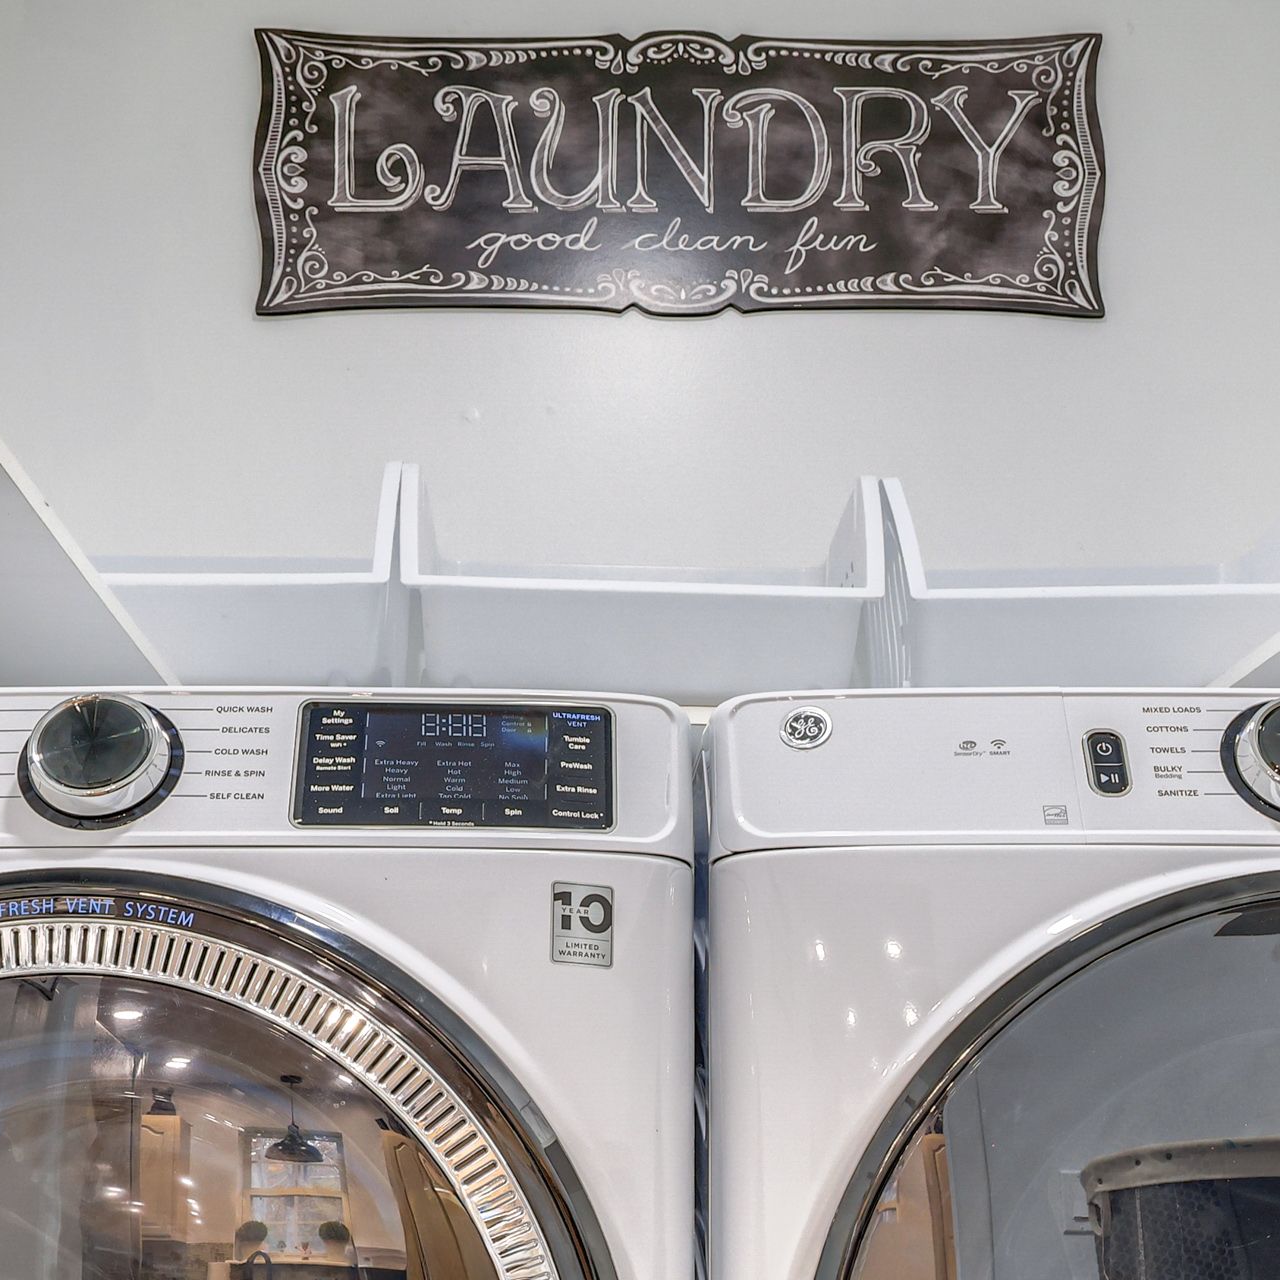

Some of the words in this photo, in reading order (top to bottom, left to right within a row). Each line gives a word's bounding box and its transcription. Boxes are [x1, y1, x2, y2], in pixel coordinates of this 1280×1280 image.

[328, 84, 1043, 214] LAUNDRY
[465, 217, 602, 269] good
[622, 217, 768, 252] clean
[785, 217, 878, 274] fun
[216, 706, 245, 714] QUICK
[552, 712, 601, 721] ULTRAFRESH
[322, 717, 353, 725] Settings
[1146, 725, 1189, 733] COTTONS
[563, 735, 590, 743] Tumble
[1150, 746, 1186, 754] TOWELS
[398, 759, 419, 767] Heavy
[560, 761, 593, 770] PreWash
[205, 769, 232, 777] RINSE
[385, 767, 408, 775] Heavy
[1153, 765, 1183, 773] BULKY
[331, 784, 354, 792] Water
[576, 786, 598, 794] Rinse
[233, 792, 265, 800] CLEAN
[1157, 789, 1199, 797] SANITIZE
[441, 807, 463, 815] Temp
[505, 808, 522, 816] Spin
[580, 811, 599, 819] Lock
[65, 897, 115, 915] VENT
[123, 900, 195, 928] SYSTEM
[554, 891, 612, 934] 10
[561, 906, 590, 915] YEAR
[565, 941, 600, 951] LIMITED
[558, 949, 606, 960] WARRANTY
